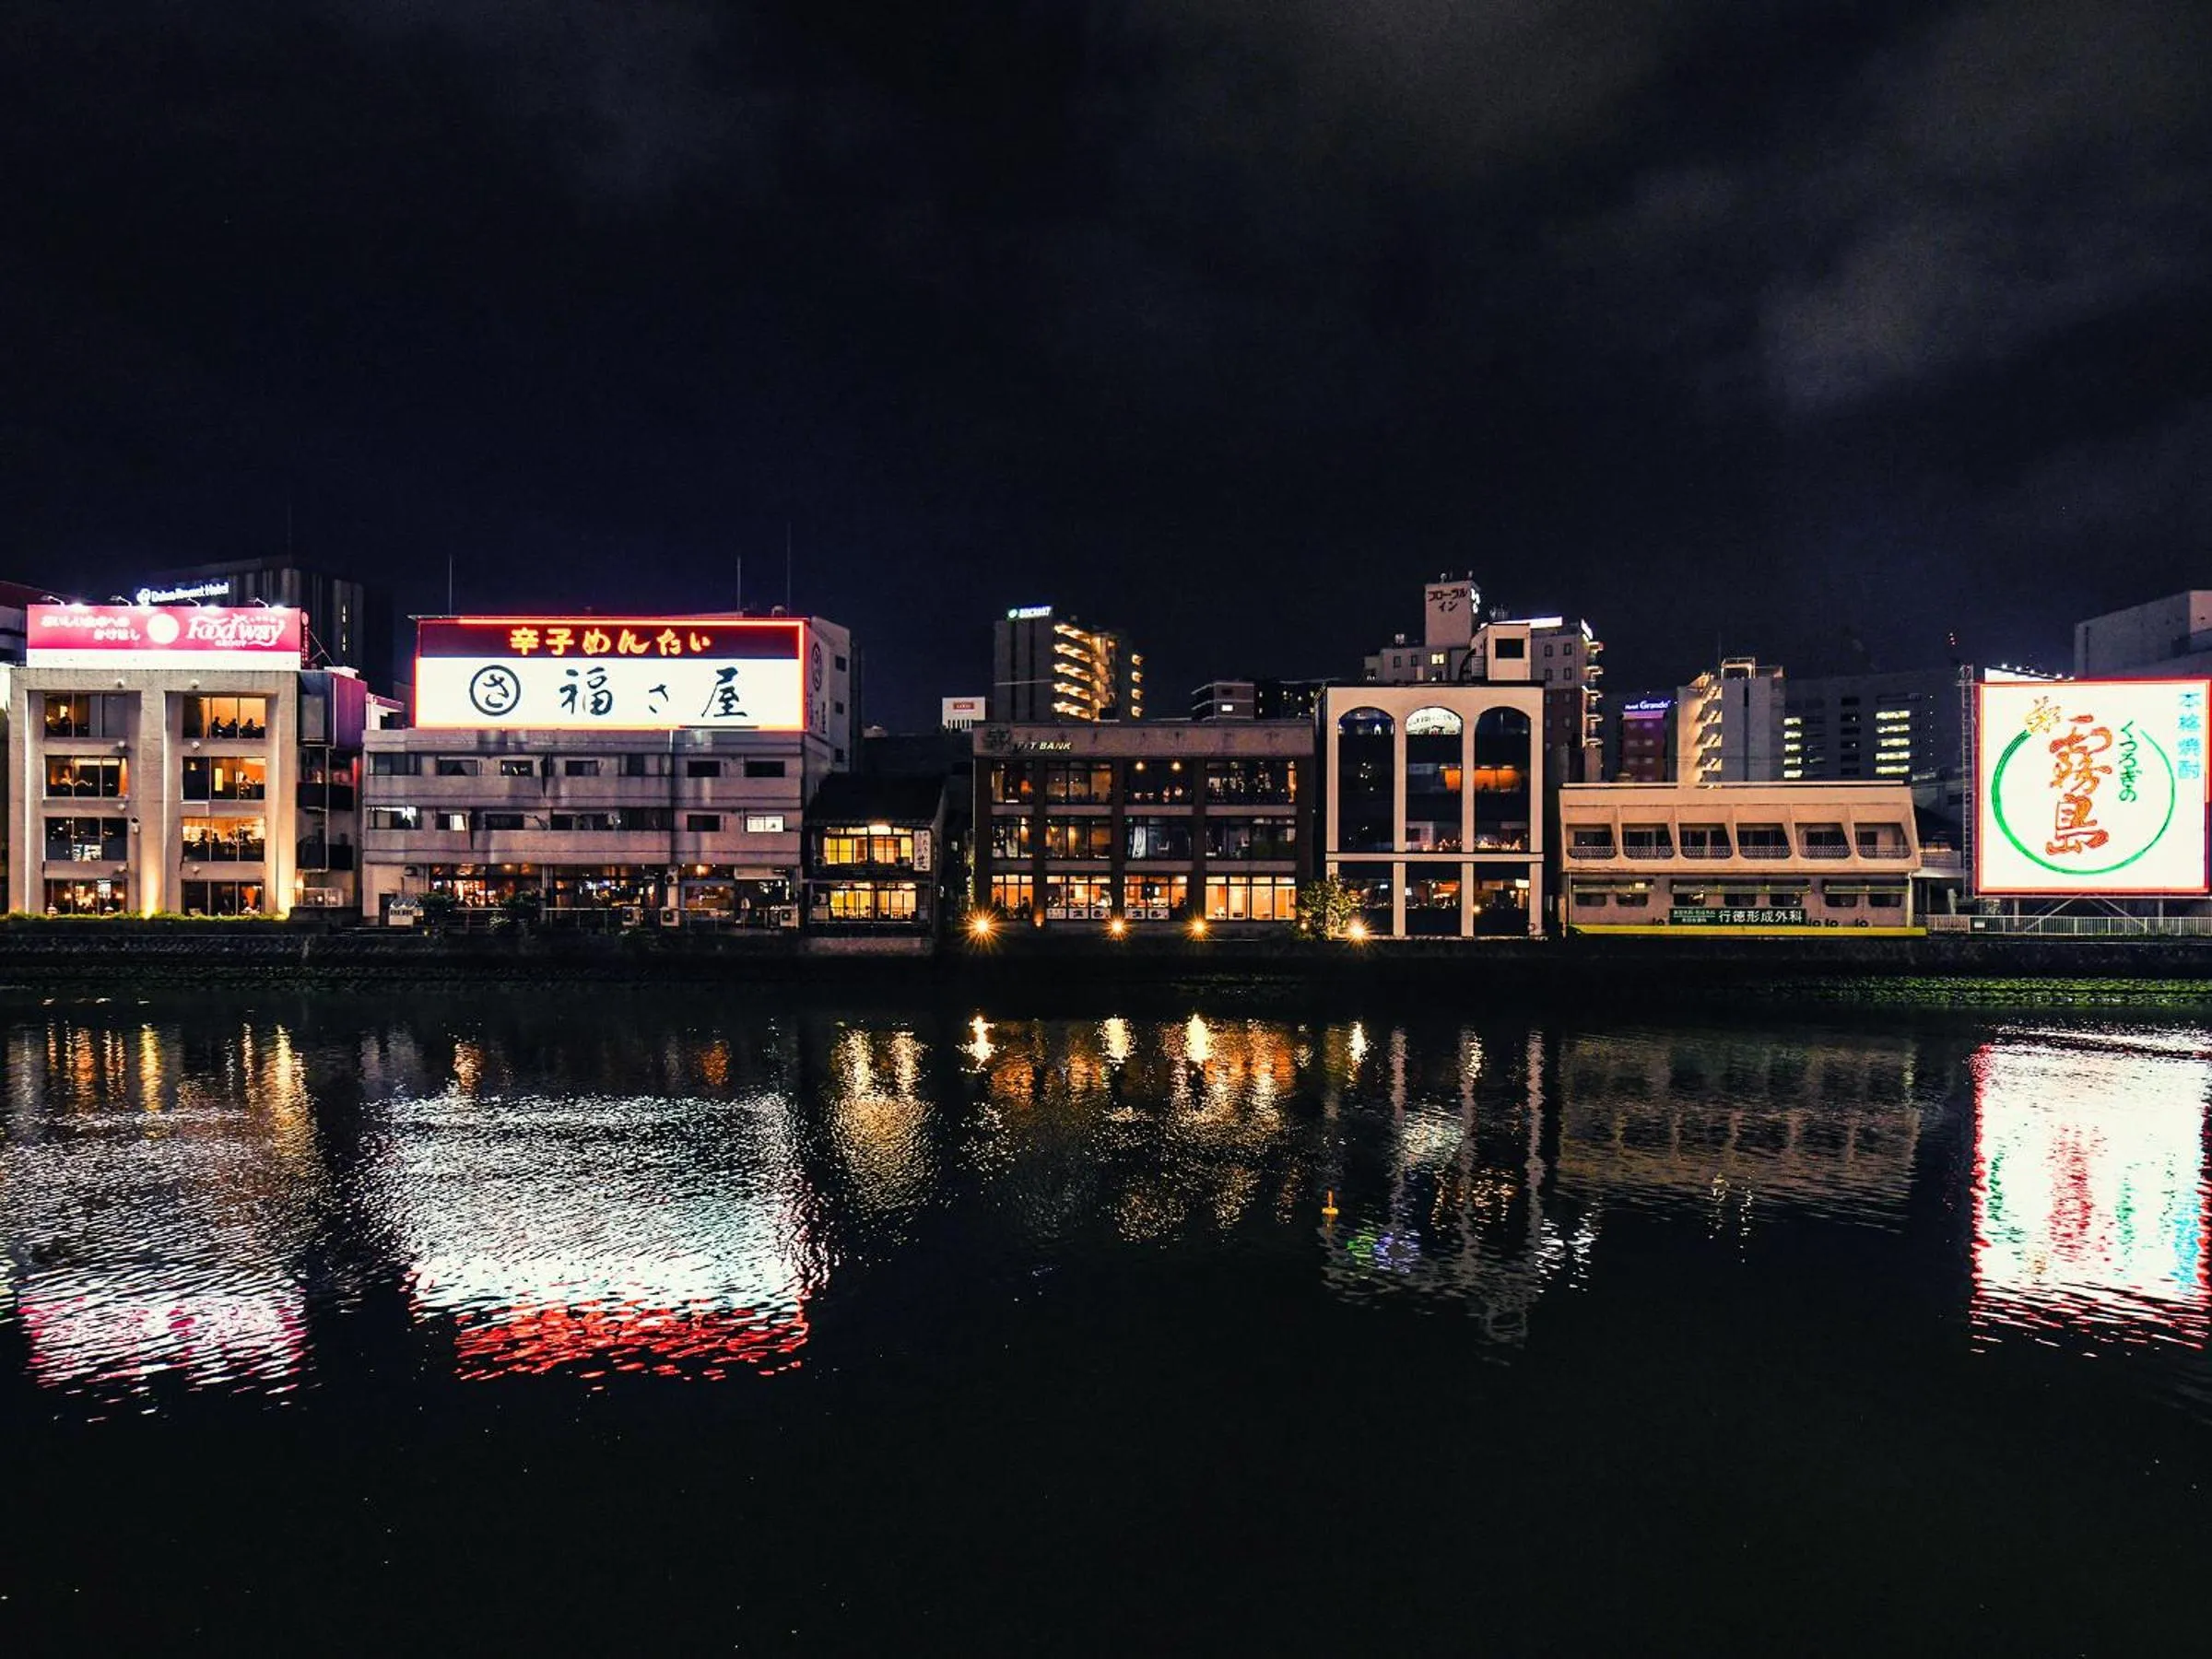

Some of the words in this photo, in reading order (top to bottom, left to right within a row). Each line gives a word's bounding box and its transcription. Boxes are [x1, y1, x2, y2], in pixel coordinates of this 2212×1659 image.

[509, 627, 712, 656] 辛子めんたい
[559, 665, 748, 718] 福さ屋
[1039, 741, 1072, 750] BANK
[1718, 910, 1804, 924] 行徳形成外科
